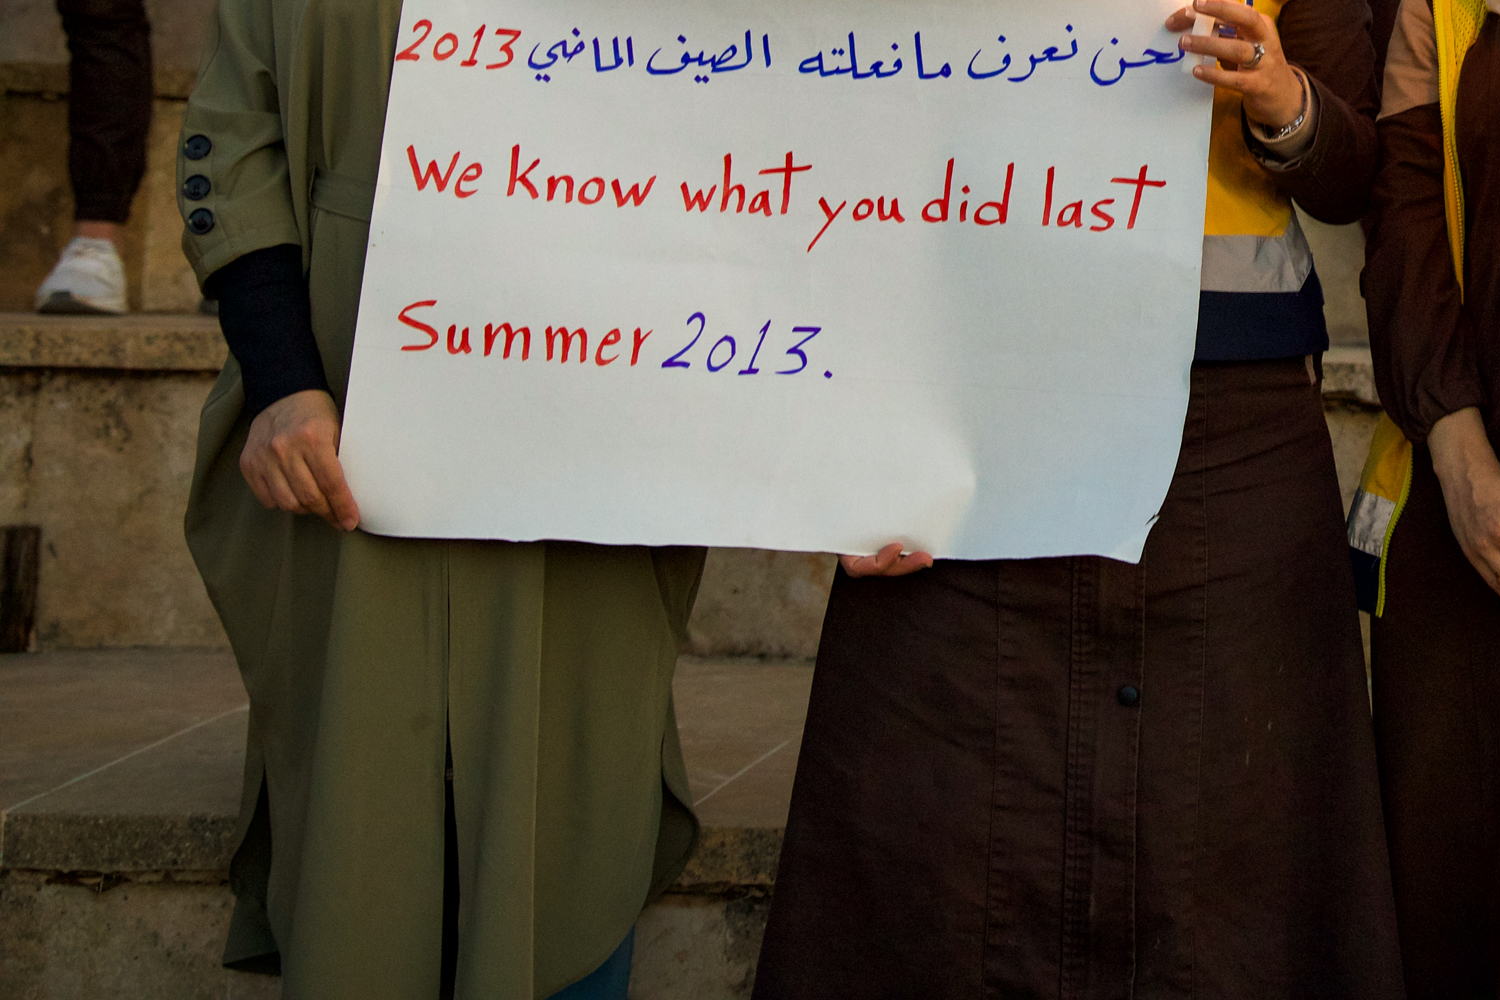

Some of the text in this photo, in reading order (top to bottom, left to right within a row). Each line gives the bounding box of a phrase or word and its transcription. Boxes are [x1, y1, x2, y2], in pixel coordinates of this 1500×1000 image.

[394, 19, 522, 70] 2013
[528, 28, 634, 83] الماضي
[646, 29, 771, 84] الصيف
[968, 24, 1078, 83] نعرف
[407, 144, 482, 199] We
[680, 151, 813, 217] what
[807, 195, 905, 253] you
[921, 157, 1014, 226] did
[1042, 164, 1166, 232] last
[398, 300, 833, 378] Summer 2013.
